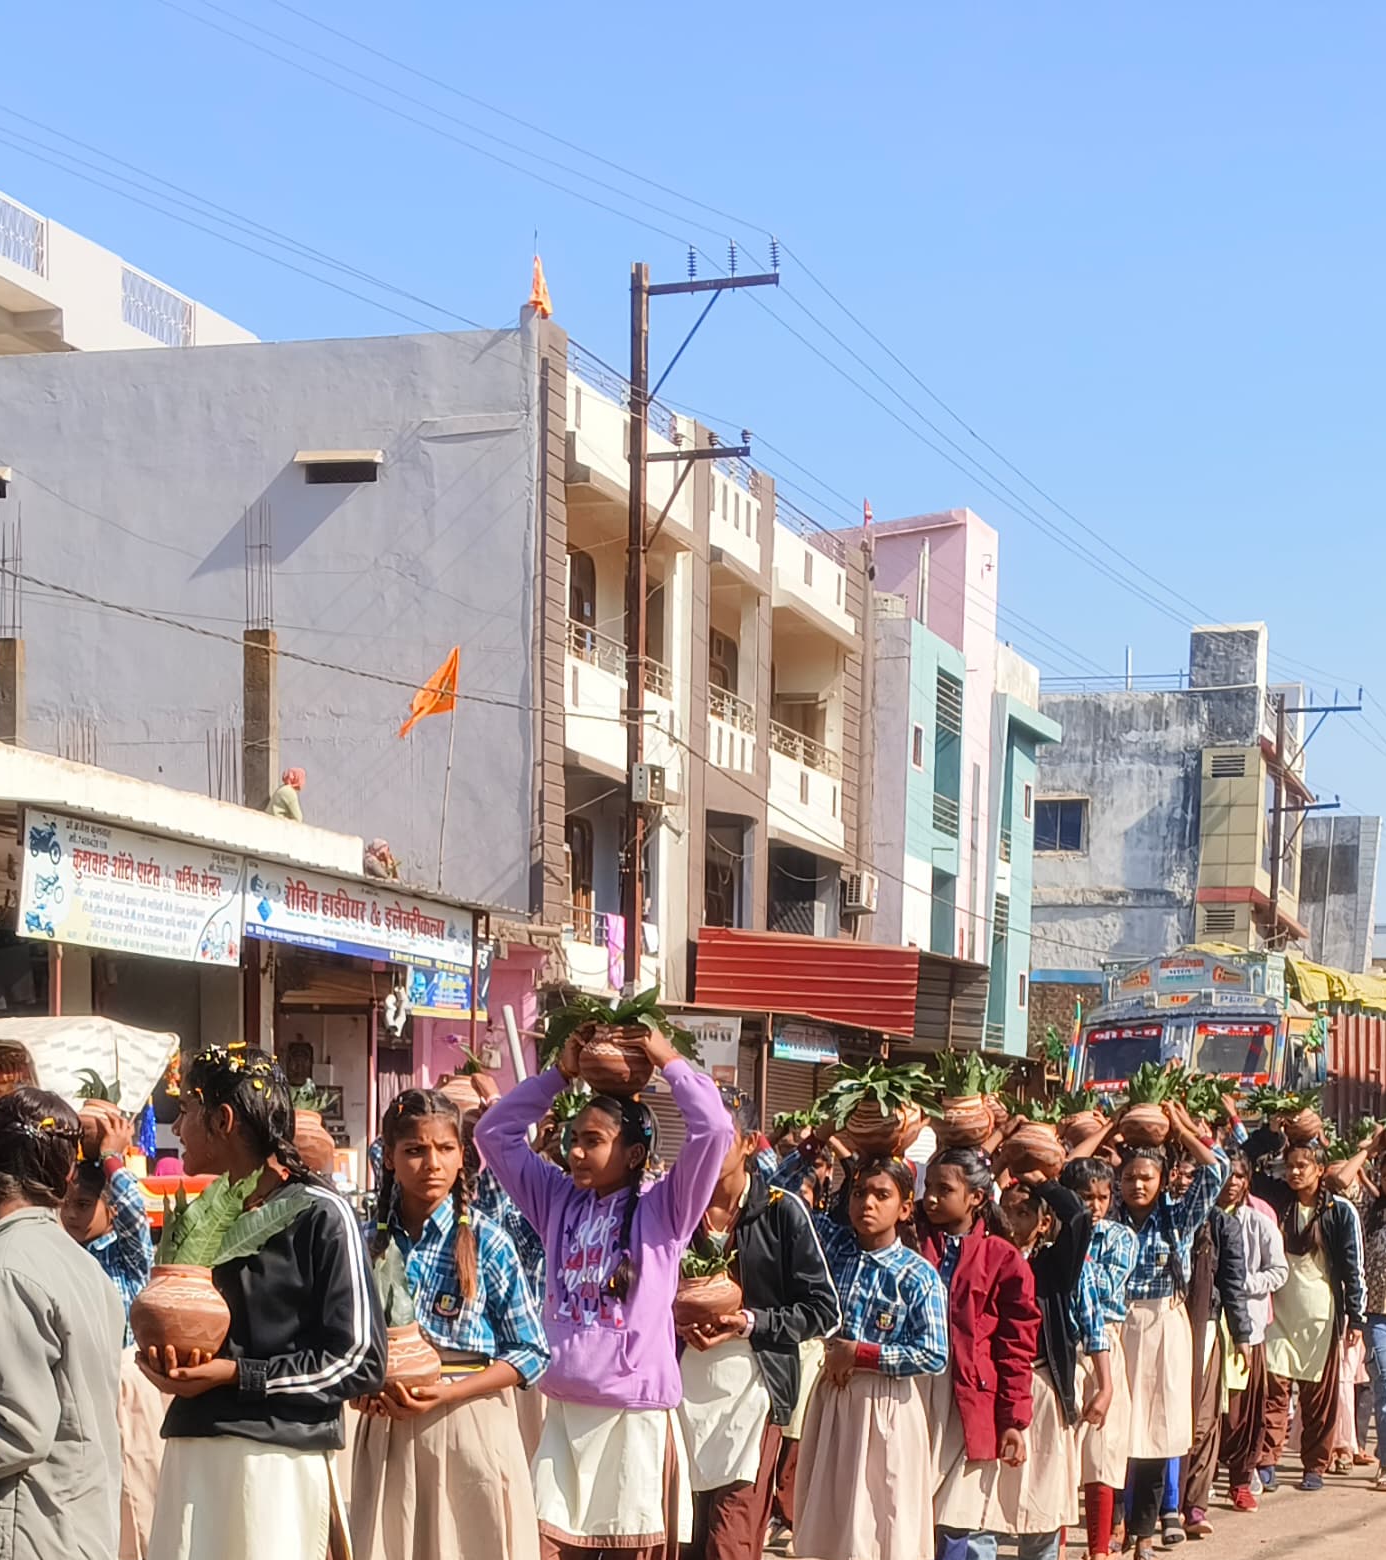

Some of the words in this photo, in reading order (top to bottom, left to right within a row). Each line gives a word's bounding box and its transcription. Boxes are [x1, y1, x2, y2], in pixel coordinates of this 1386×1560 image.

[72, 848, 109, 879] कुशवाह
[111, 851, 134, 881] ऑटो
[285, 876, 318, 915] रोहित
